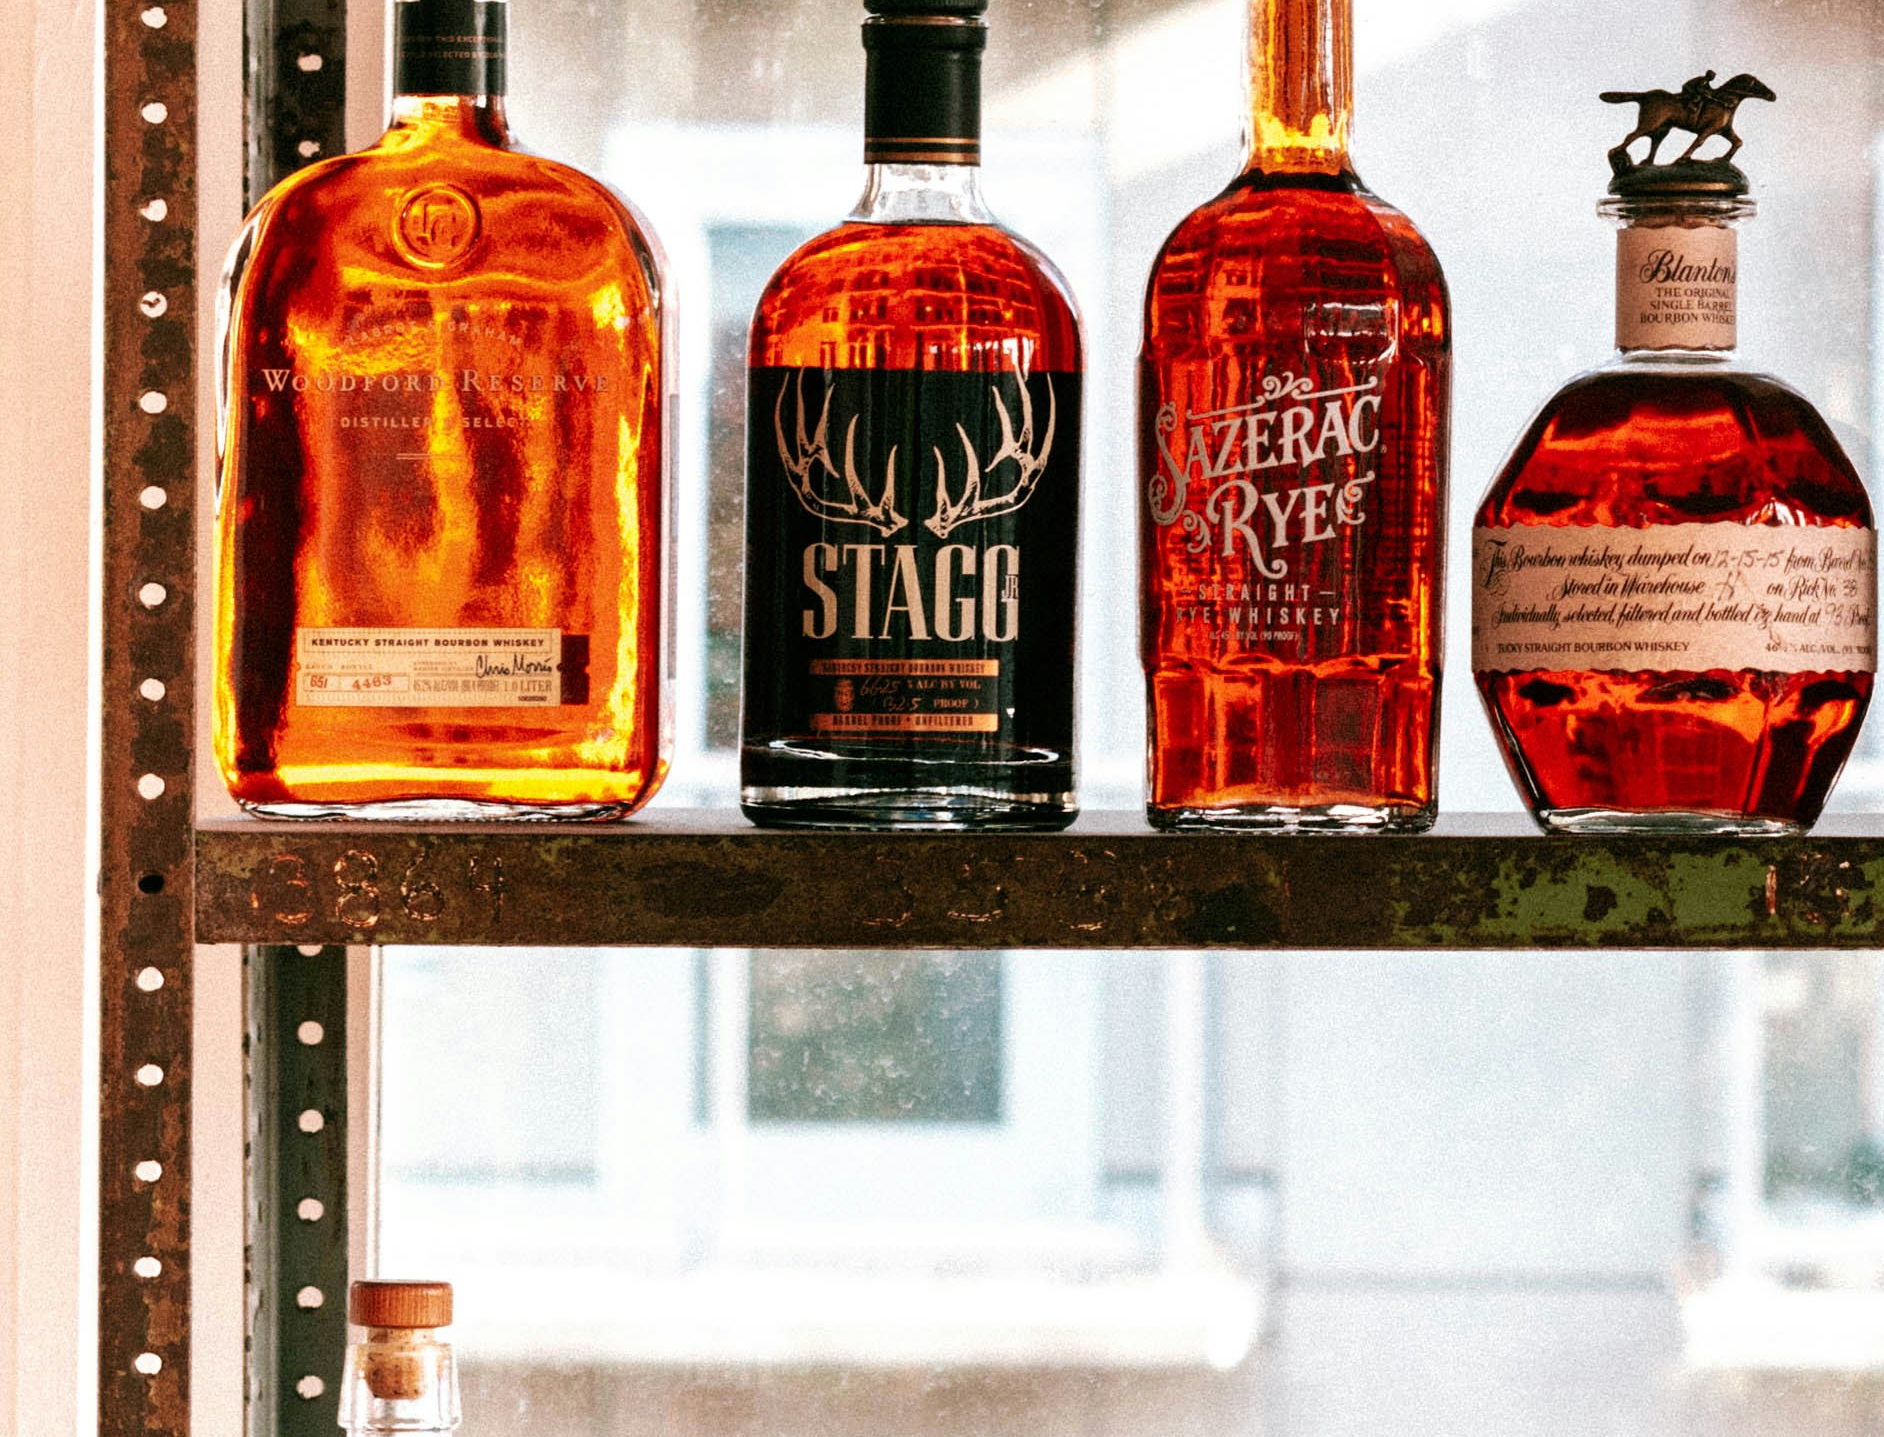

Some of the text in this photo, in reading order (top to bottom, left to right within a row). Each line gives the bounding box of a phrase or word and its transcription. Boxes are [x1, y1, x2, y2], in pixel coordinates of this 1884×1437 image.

[262, 368, 610, 393] WOODFORD RESERVE
[1150, 395, 1382, 525] SAZERAC
[1205, 480, 1337, 579] RYE
[803, 542, 1020, 642] STAGG
[1198, 582, 1311, 601] STRAIGHT
[1228, 607, 1340, 626] WHISKEY
[311, 637, 545, 649] KENTUCKY STRAIGHT BOURBON WHISKEY
